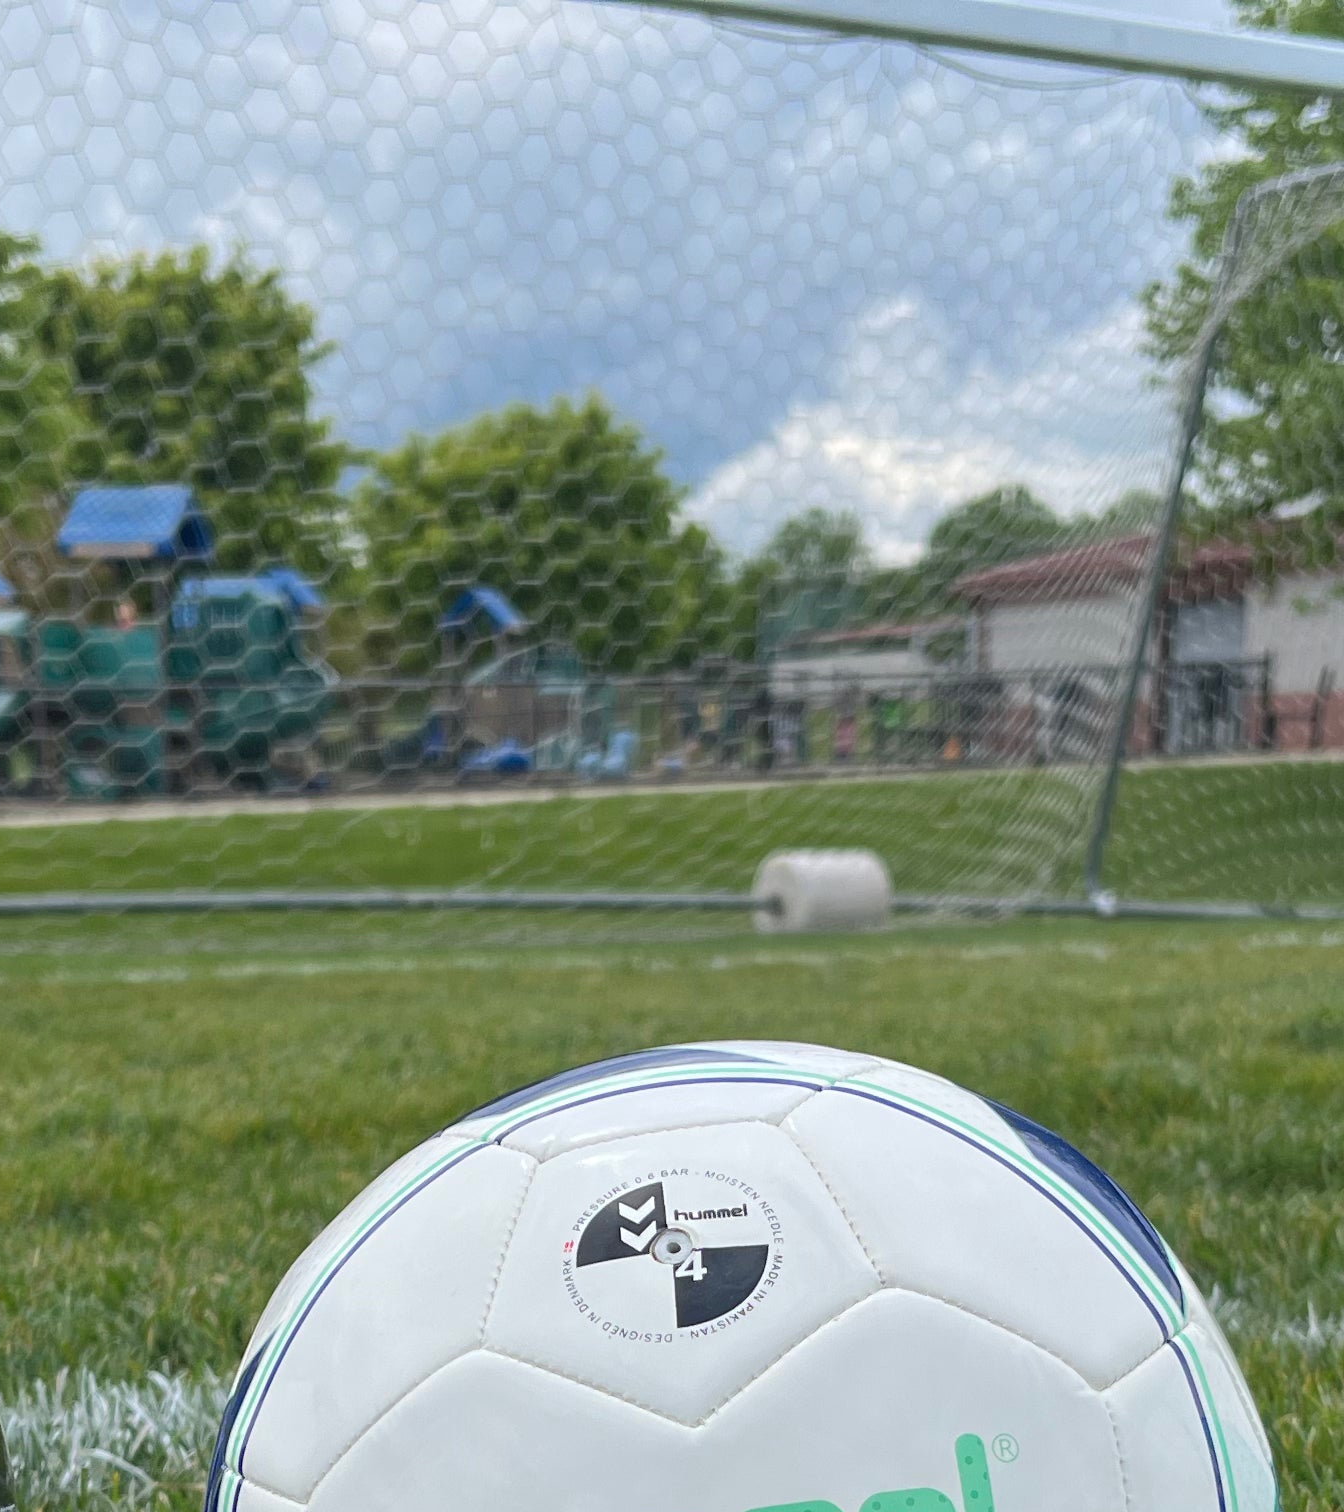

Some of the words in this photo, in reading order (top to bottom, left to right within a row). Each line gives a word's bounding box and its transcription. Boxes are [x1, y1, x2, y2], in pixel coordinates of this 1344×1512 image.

[704, 1170, 760, 1201] MOISTEN
[572, 1181, 630, 1232] PRESSURE
[674, 1203, 748, 1221] hummel
[759, 1201, 784, 1244] NEEDLE
[675, 1250, 708, 1281] 4
[765, 1253, 784, 1288] MADE
[562, 1258, 588, 1314] DENMARK
[753, 1289, 768, 1303] IN
[586, 1307, 603, 1324] IN
[689, 1302, 754, 1339] PAKISTAN
[601, 1320, 673, 1343] DESIGNED
